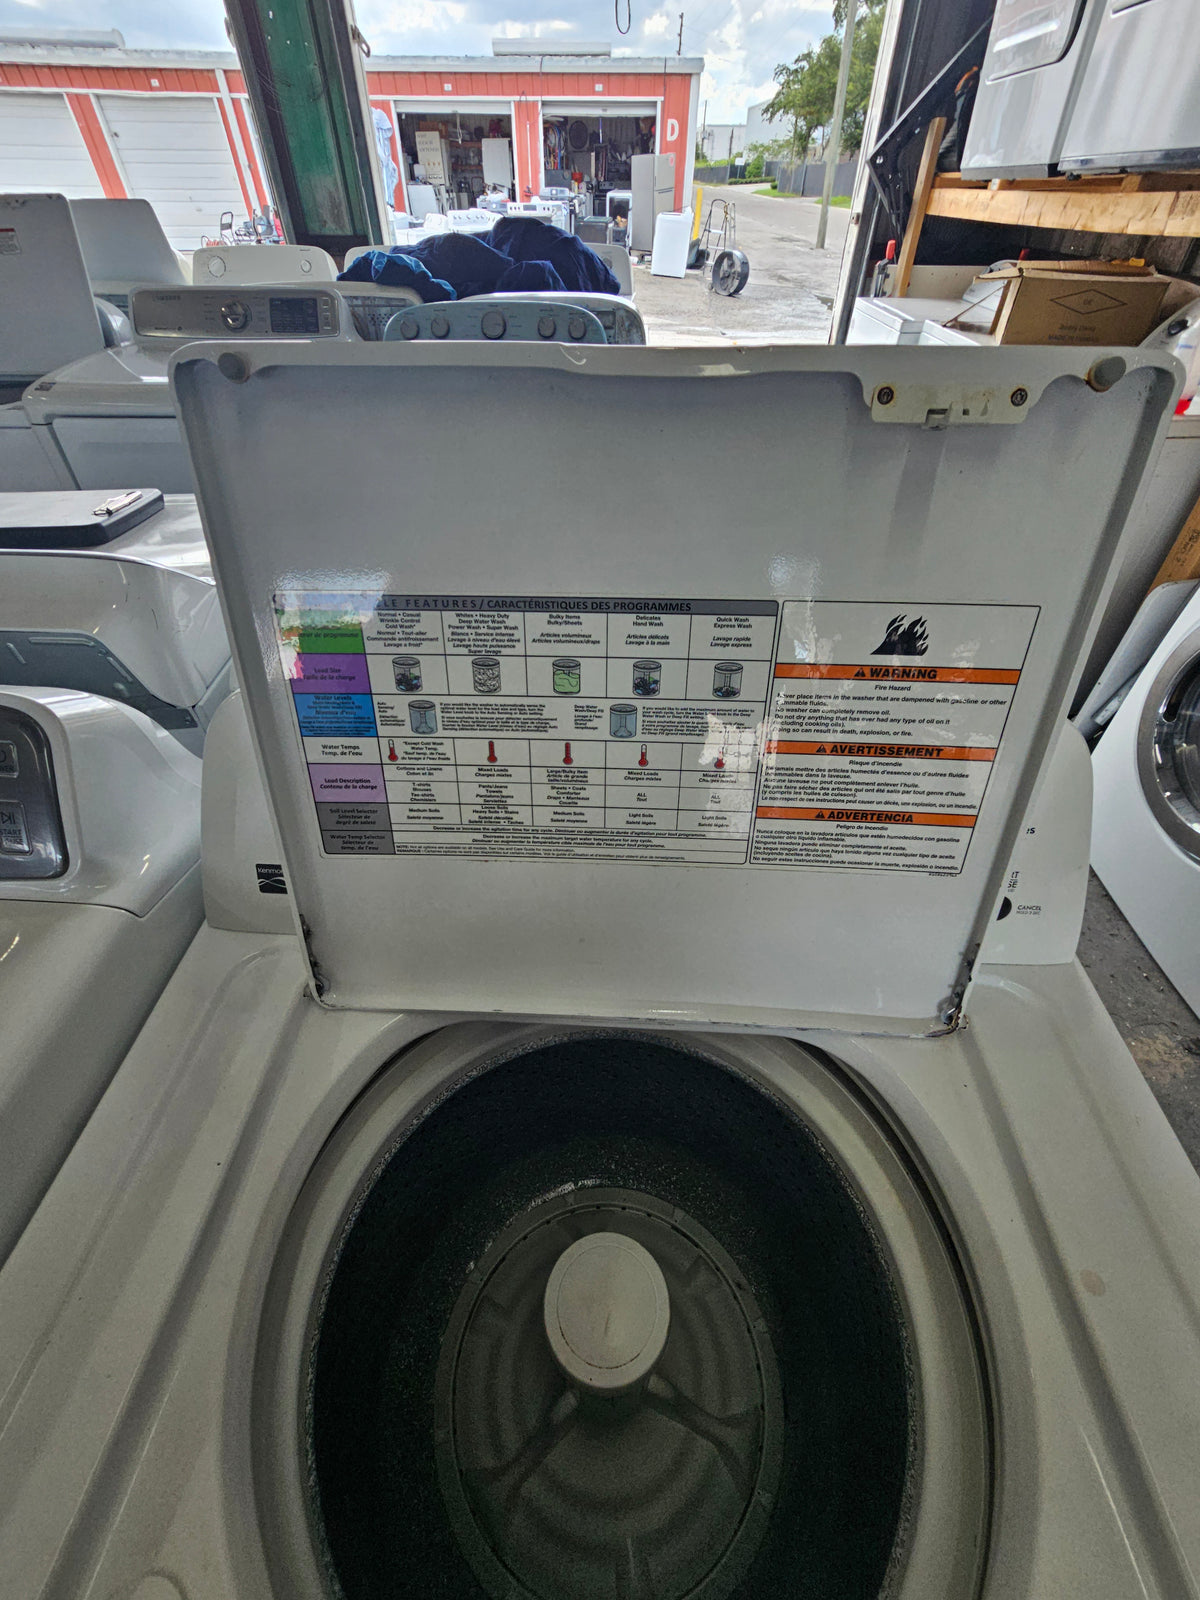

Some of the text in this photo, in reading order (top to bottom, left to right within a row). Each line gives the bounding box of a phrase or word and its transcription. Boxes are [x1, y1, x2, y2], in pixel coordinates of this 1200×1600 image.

[666, 118, 679, 142] D
[590, 601, 611, 610] DES
[613, 602, 692, 612] PROGRAMMES
[870, 668, 938, 679] WARNING
[830, 745, 944, 757] AVERTISSEMENT
[827, 811, 914, 823] ADVERTENCIA
